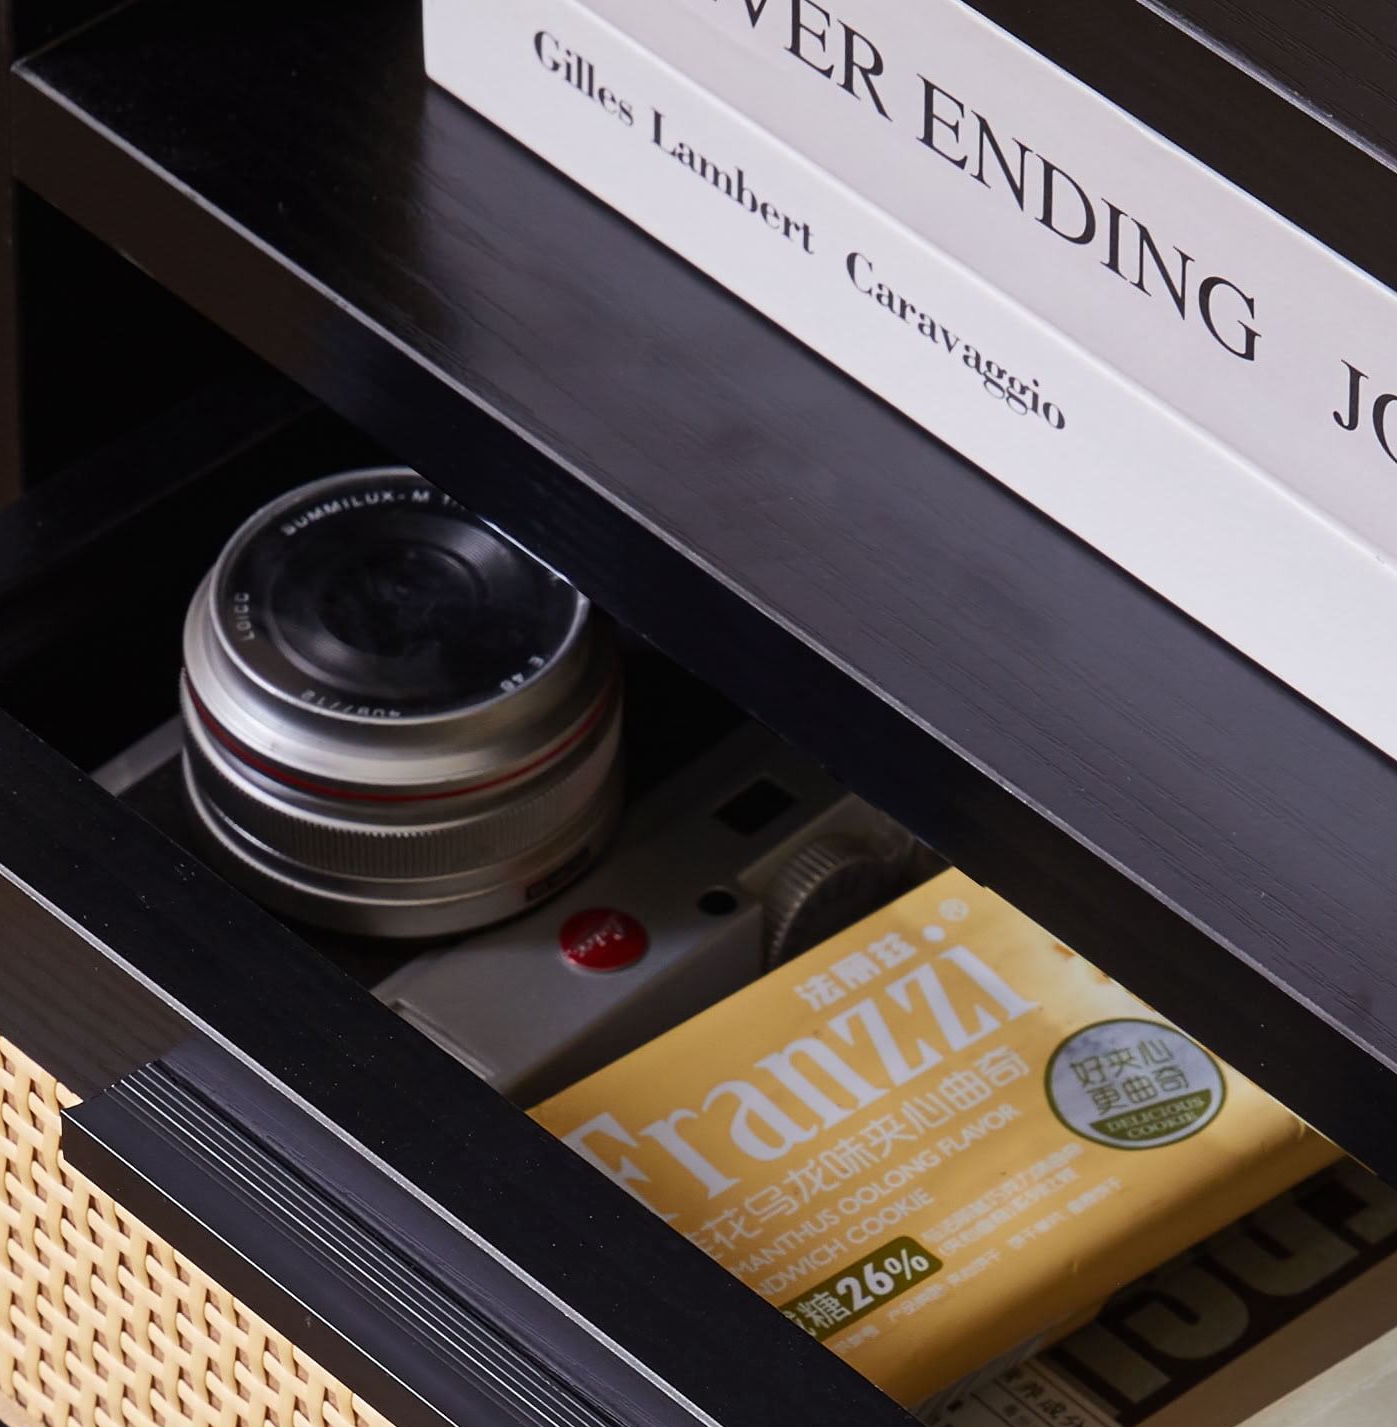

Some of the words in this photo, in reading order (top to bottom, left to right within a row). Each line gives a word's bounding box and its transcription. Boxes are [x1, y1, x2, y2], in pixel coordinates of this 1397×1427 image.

[533, 29, 635, 126] Gilles
[650, 107, 816, 255] Lambert
[846, 251, 1067, 432] Caravaggio
[916, 73, 1262, 362] ENDING
[564, 925, 1039, 1222] Franzzi
[1070, 1038, 1175, 1088] 好夹心
[1085, 1064, 1191, 1117] 更曲奇
[1104, 1096, 1204, 1134] DELICIOUS
[1126, 1111, 1199, 1142] COOKIE
[734, 1211, 841, 1280] MANTHUS
[836, 1149, 942, 1224] OOLONG
[937, 1102, 1023, 1167] FLAVOR
[757, 1230, 846, 1298] DWICH
[845, 1186, 936, 1244] COOKIE
